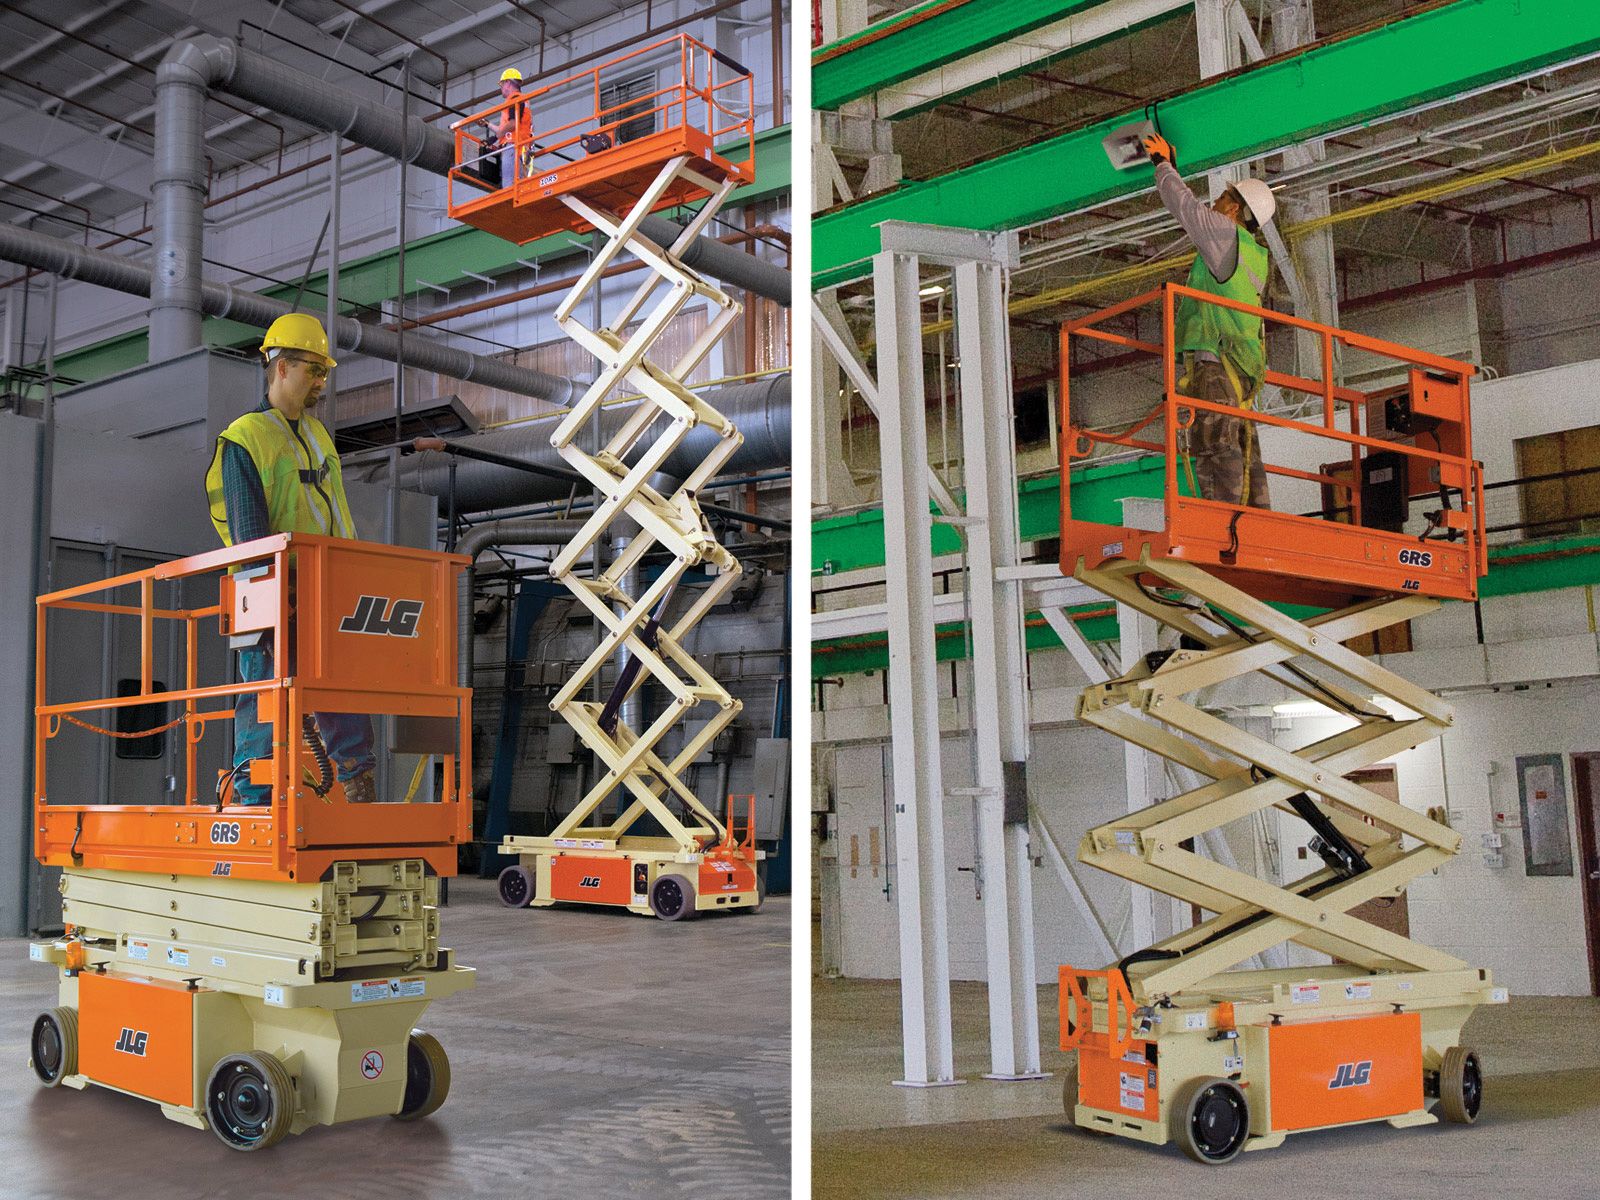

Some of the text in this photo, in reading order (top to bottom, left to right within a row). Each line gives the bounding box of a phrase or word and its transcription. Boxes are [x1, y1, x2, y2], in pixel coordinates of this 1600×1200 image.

[1399, 549, 1432, 567] 6RS
[1402, 579, 1420, 590] JLG
[338, 595, 423, 637] JLG
[211, 822, 240, 844] 6RS
[212, 861, 232, 876] JLG
[579, 876, 601, 888] JLG
[115, 1028, 148, 1057] JLG
[1328, 1061, 1372, 1089] JLG
